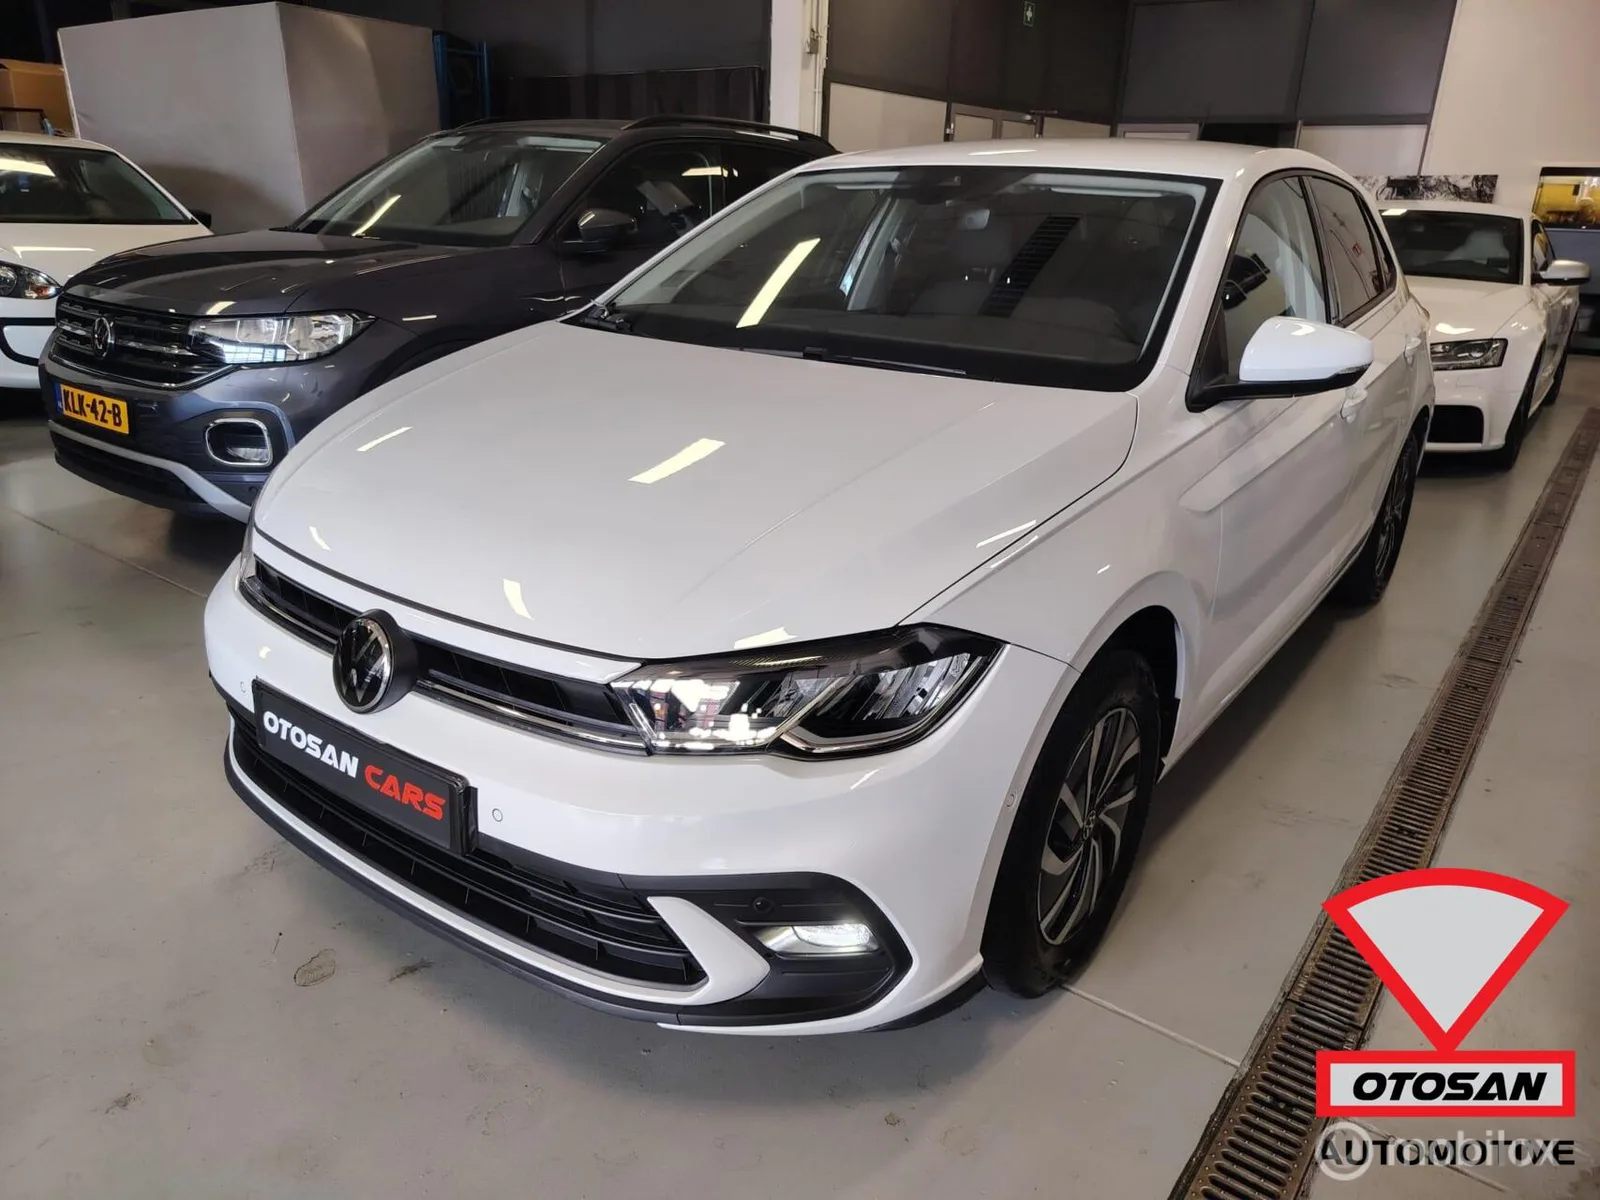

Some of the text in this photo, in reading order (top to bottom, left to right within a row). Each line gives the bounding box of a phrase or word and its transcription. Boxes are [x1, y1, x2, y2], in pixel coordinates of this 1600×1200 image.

[62, 388, 123, 428] KLK-42-B
[262, 710, 447, 821] OTOSAN CARS
